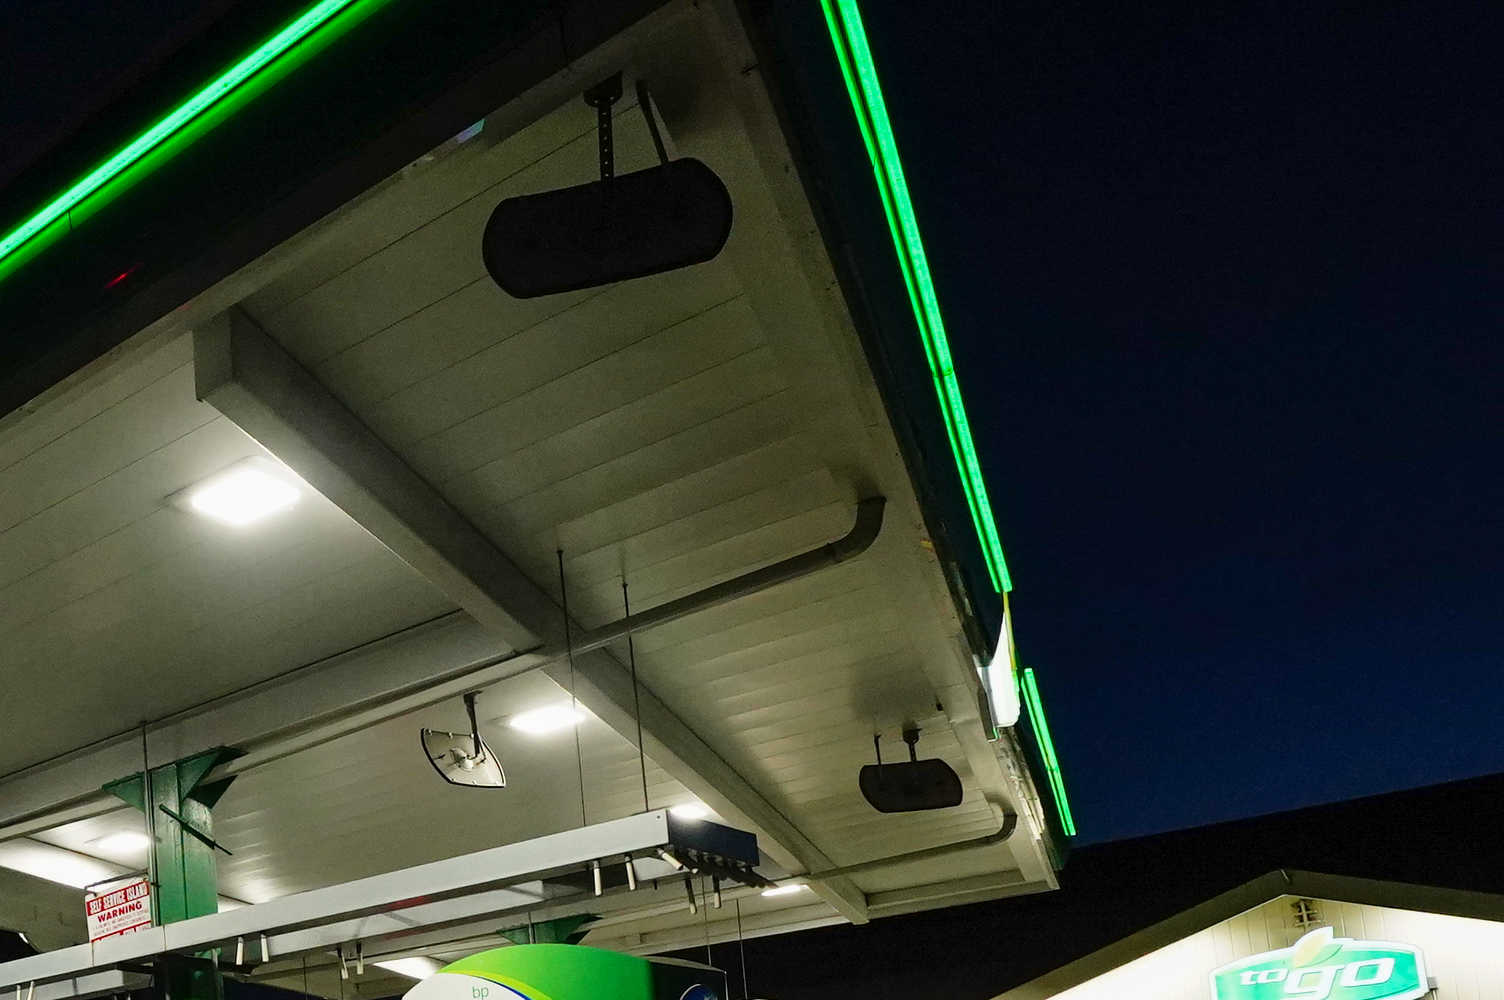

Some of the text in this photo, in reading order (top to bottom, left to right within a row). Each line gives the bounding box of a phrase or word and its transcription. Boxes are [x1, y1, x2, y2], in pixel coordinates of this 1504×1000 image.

[89, 899, 103, 914] SELF
[103, 890, 126, 910] SERVICE
[98, 901, 143, 922] WARNING
[472, 986, 489, 1000] bp
